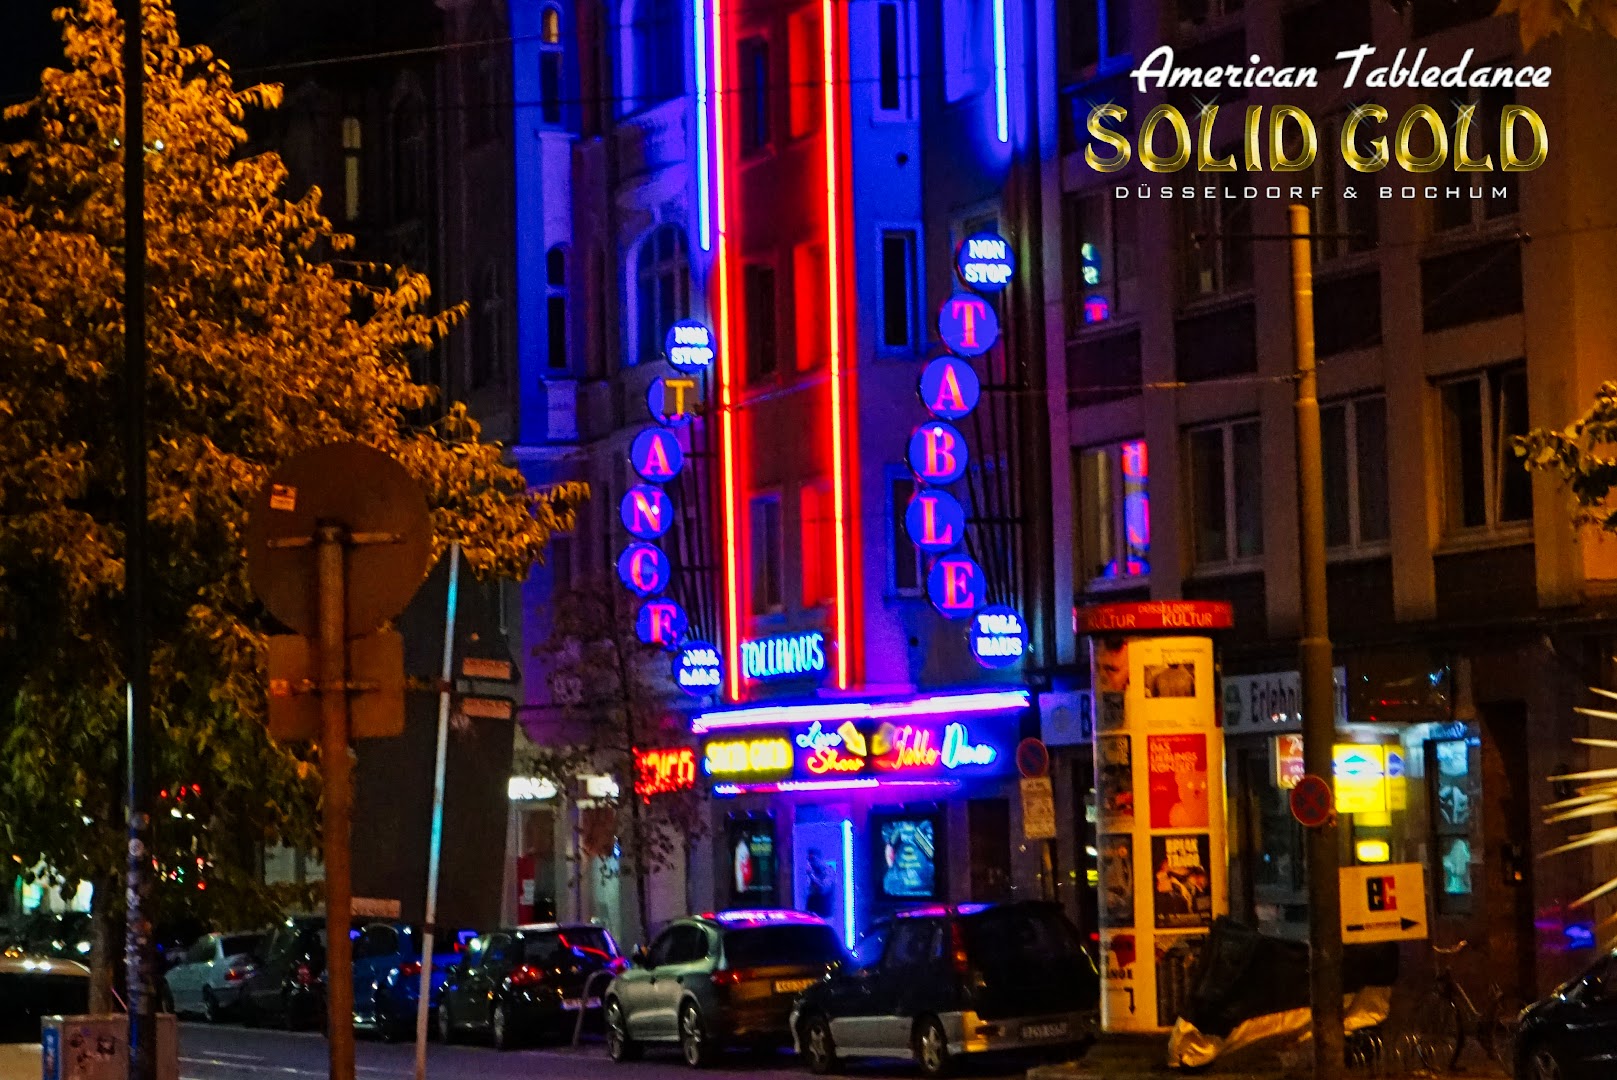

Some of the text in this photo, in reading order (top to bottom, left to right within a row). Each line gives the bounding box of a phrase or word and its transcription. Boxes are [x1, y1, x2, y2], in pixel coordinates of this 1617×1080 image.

[969, 239, 1006, 260] NON
[965, 263, 1012, 284] STOP
[671, 347, 714, 365] STOP
[1162, 612, 1213, 627] KULTUR
